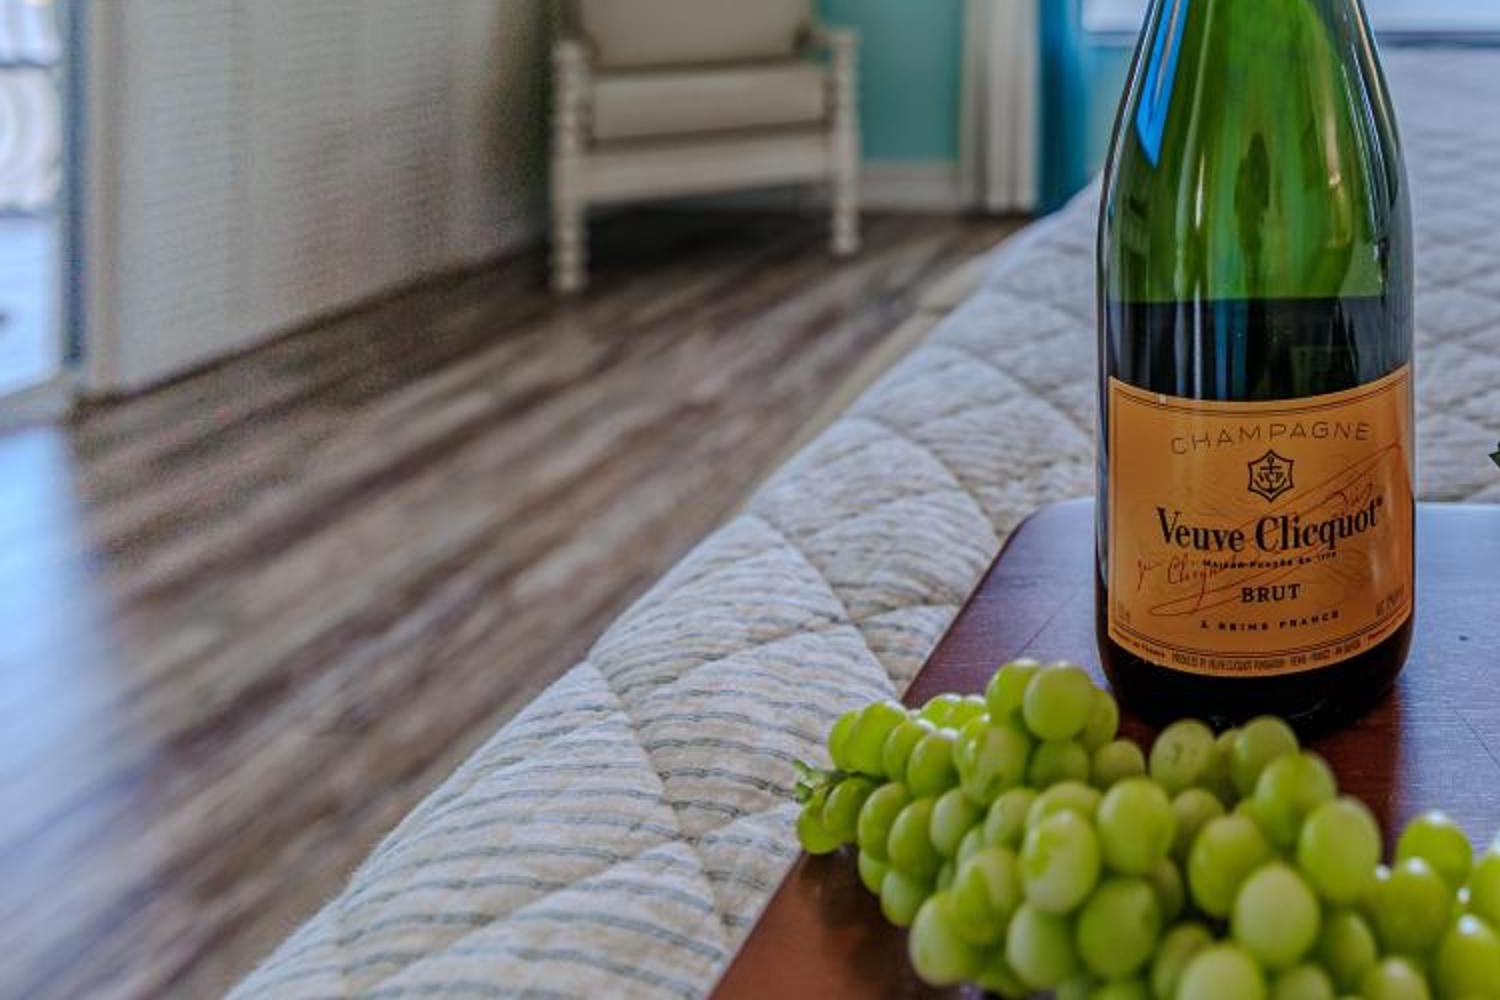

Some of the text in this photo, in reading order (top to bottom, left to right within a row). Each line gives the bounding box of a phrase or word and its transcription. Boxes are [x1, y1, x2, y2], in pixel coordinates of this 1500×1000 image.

[1171, 421, 1370, 455] CHAMPAGNE
[1156, 500, 1378, 553] Veuve Clicquot
[1240, 583, 1301, 603] BRUT
[1279, 609, 1340, 629] FRANCE
